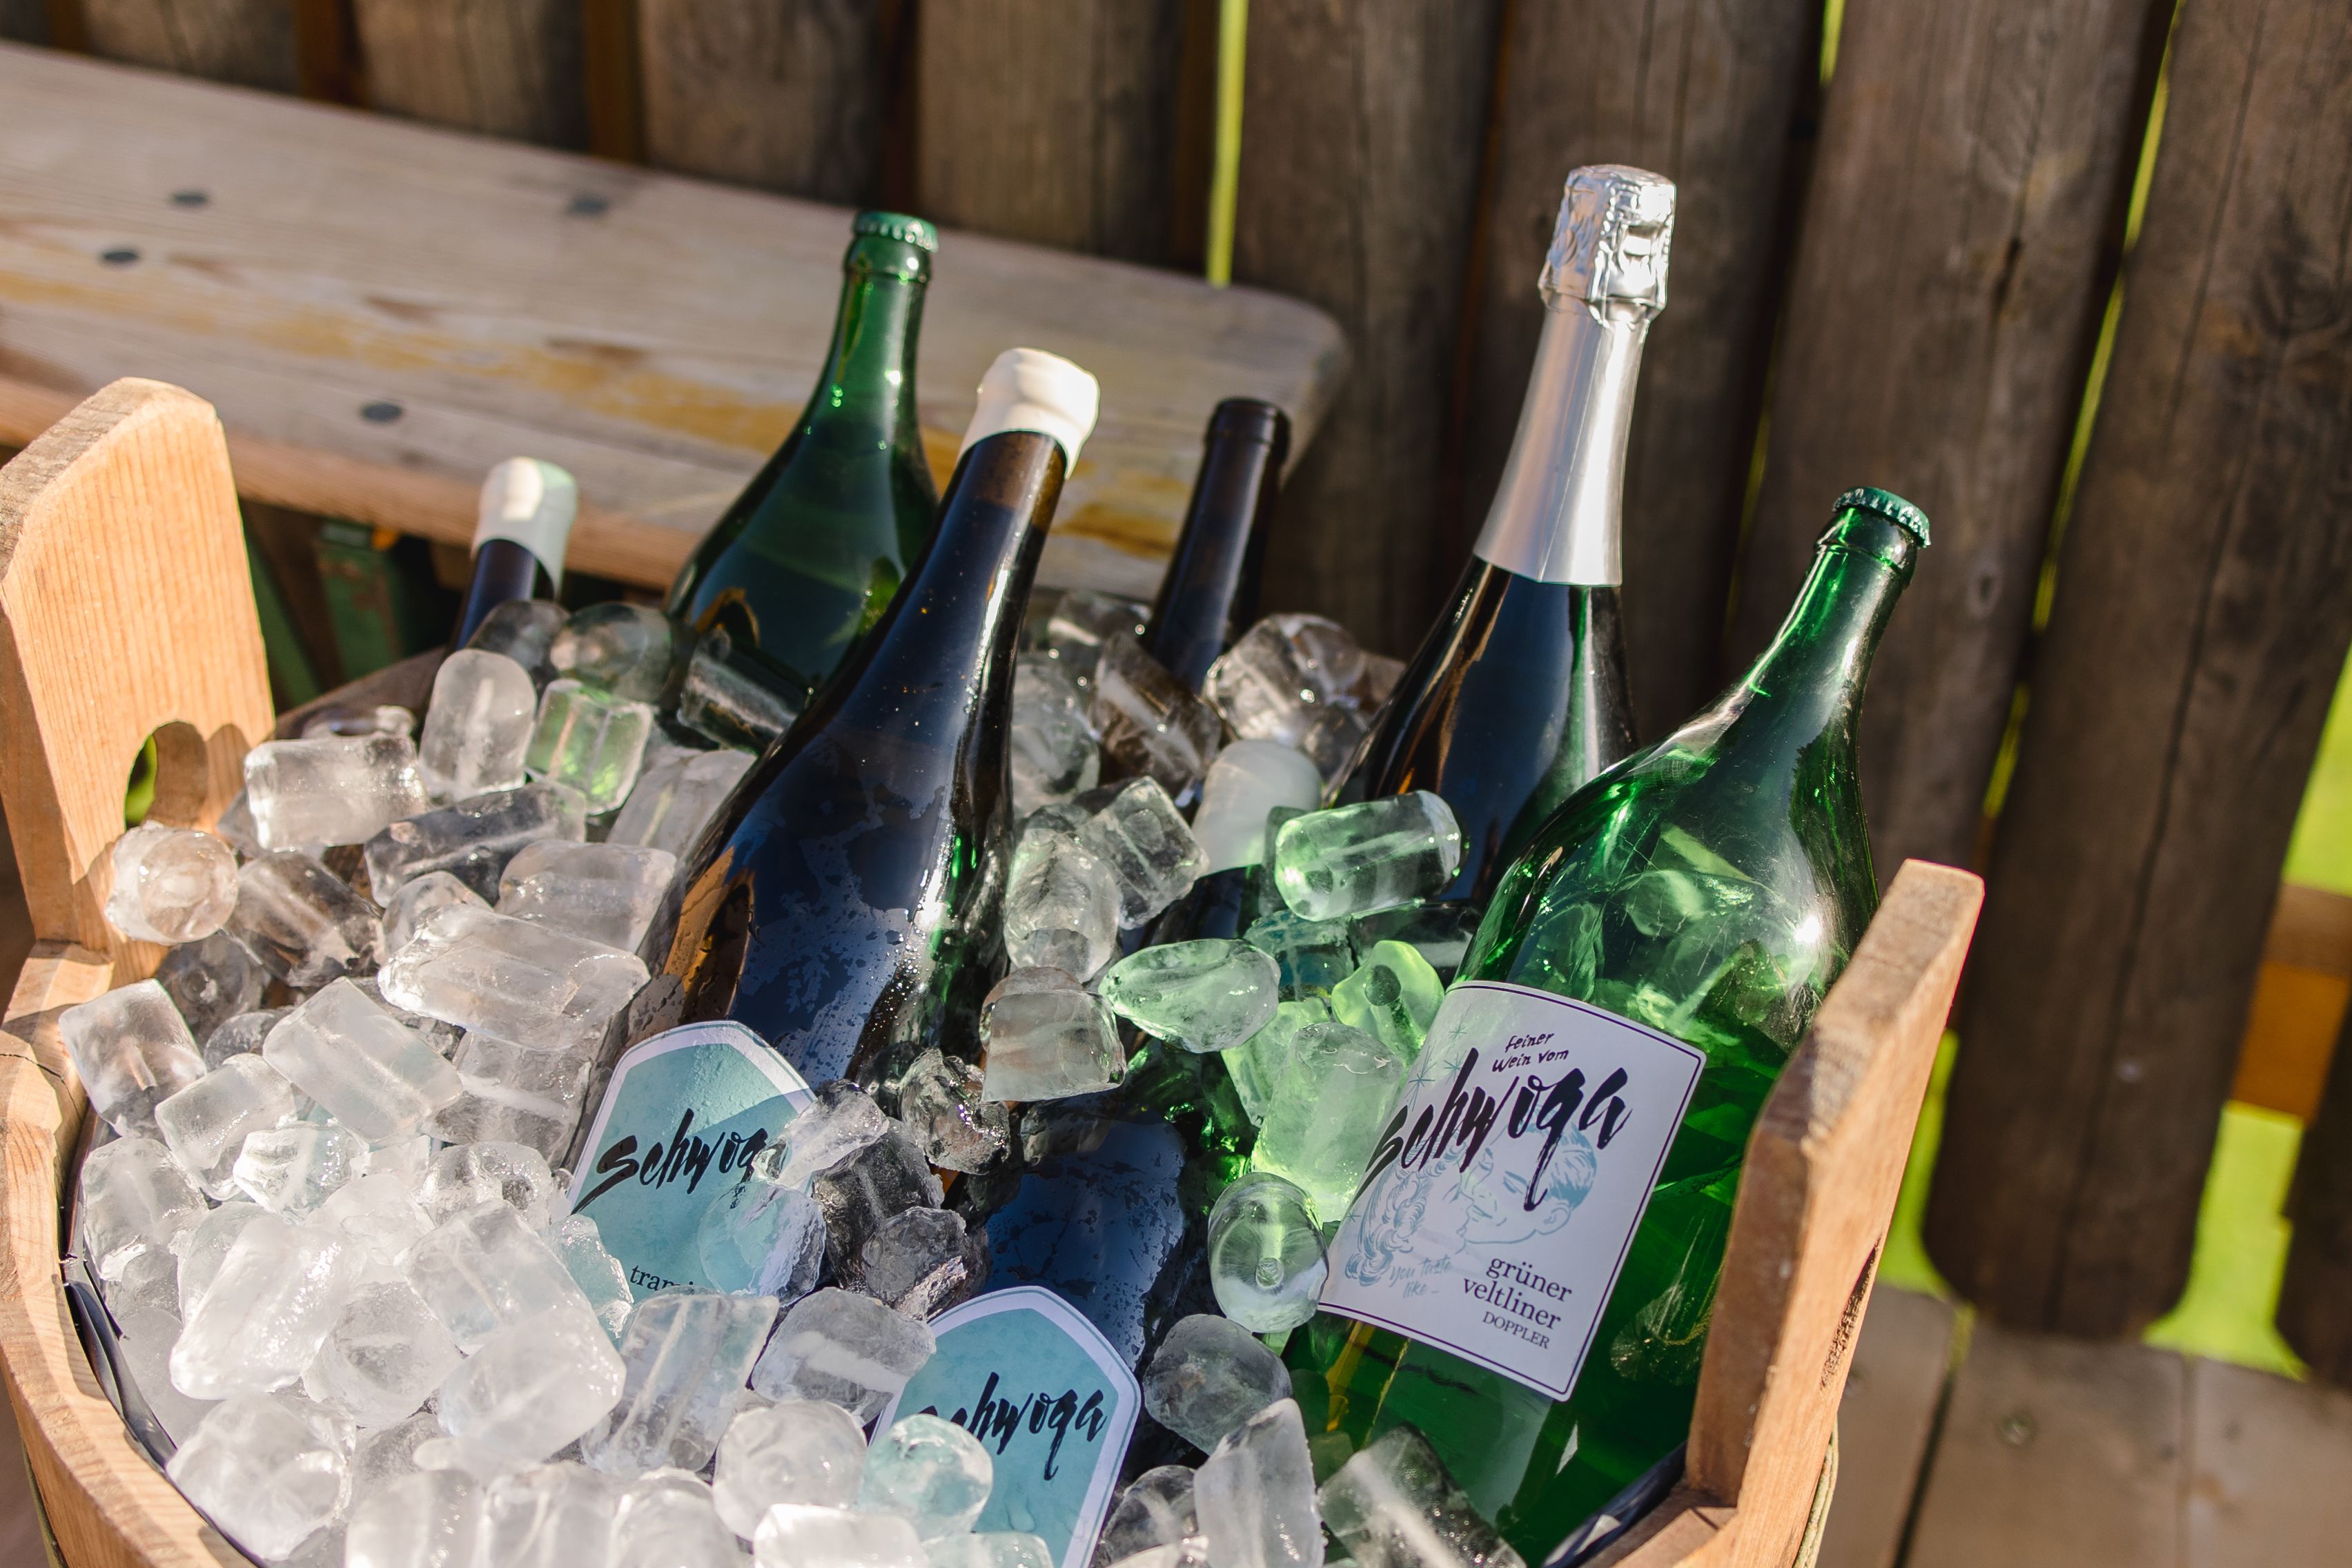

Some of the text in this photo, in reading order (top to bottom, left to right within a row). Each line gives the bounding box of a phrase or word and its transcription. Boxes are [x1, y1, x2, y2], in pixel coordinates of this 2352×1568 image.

[1486, 1258, 1573, 1302] grüner
[1463, 1278, 1562, 1330] veltliner
[1482, 1311, 1550, 1350] DOPPLER
